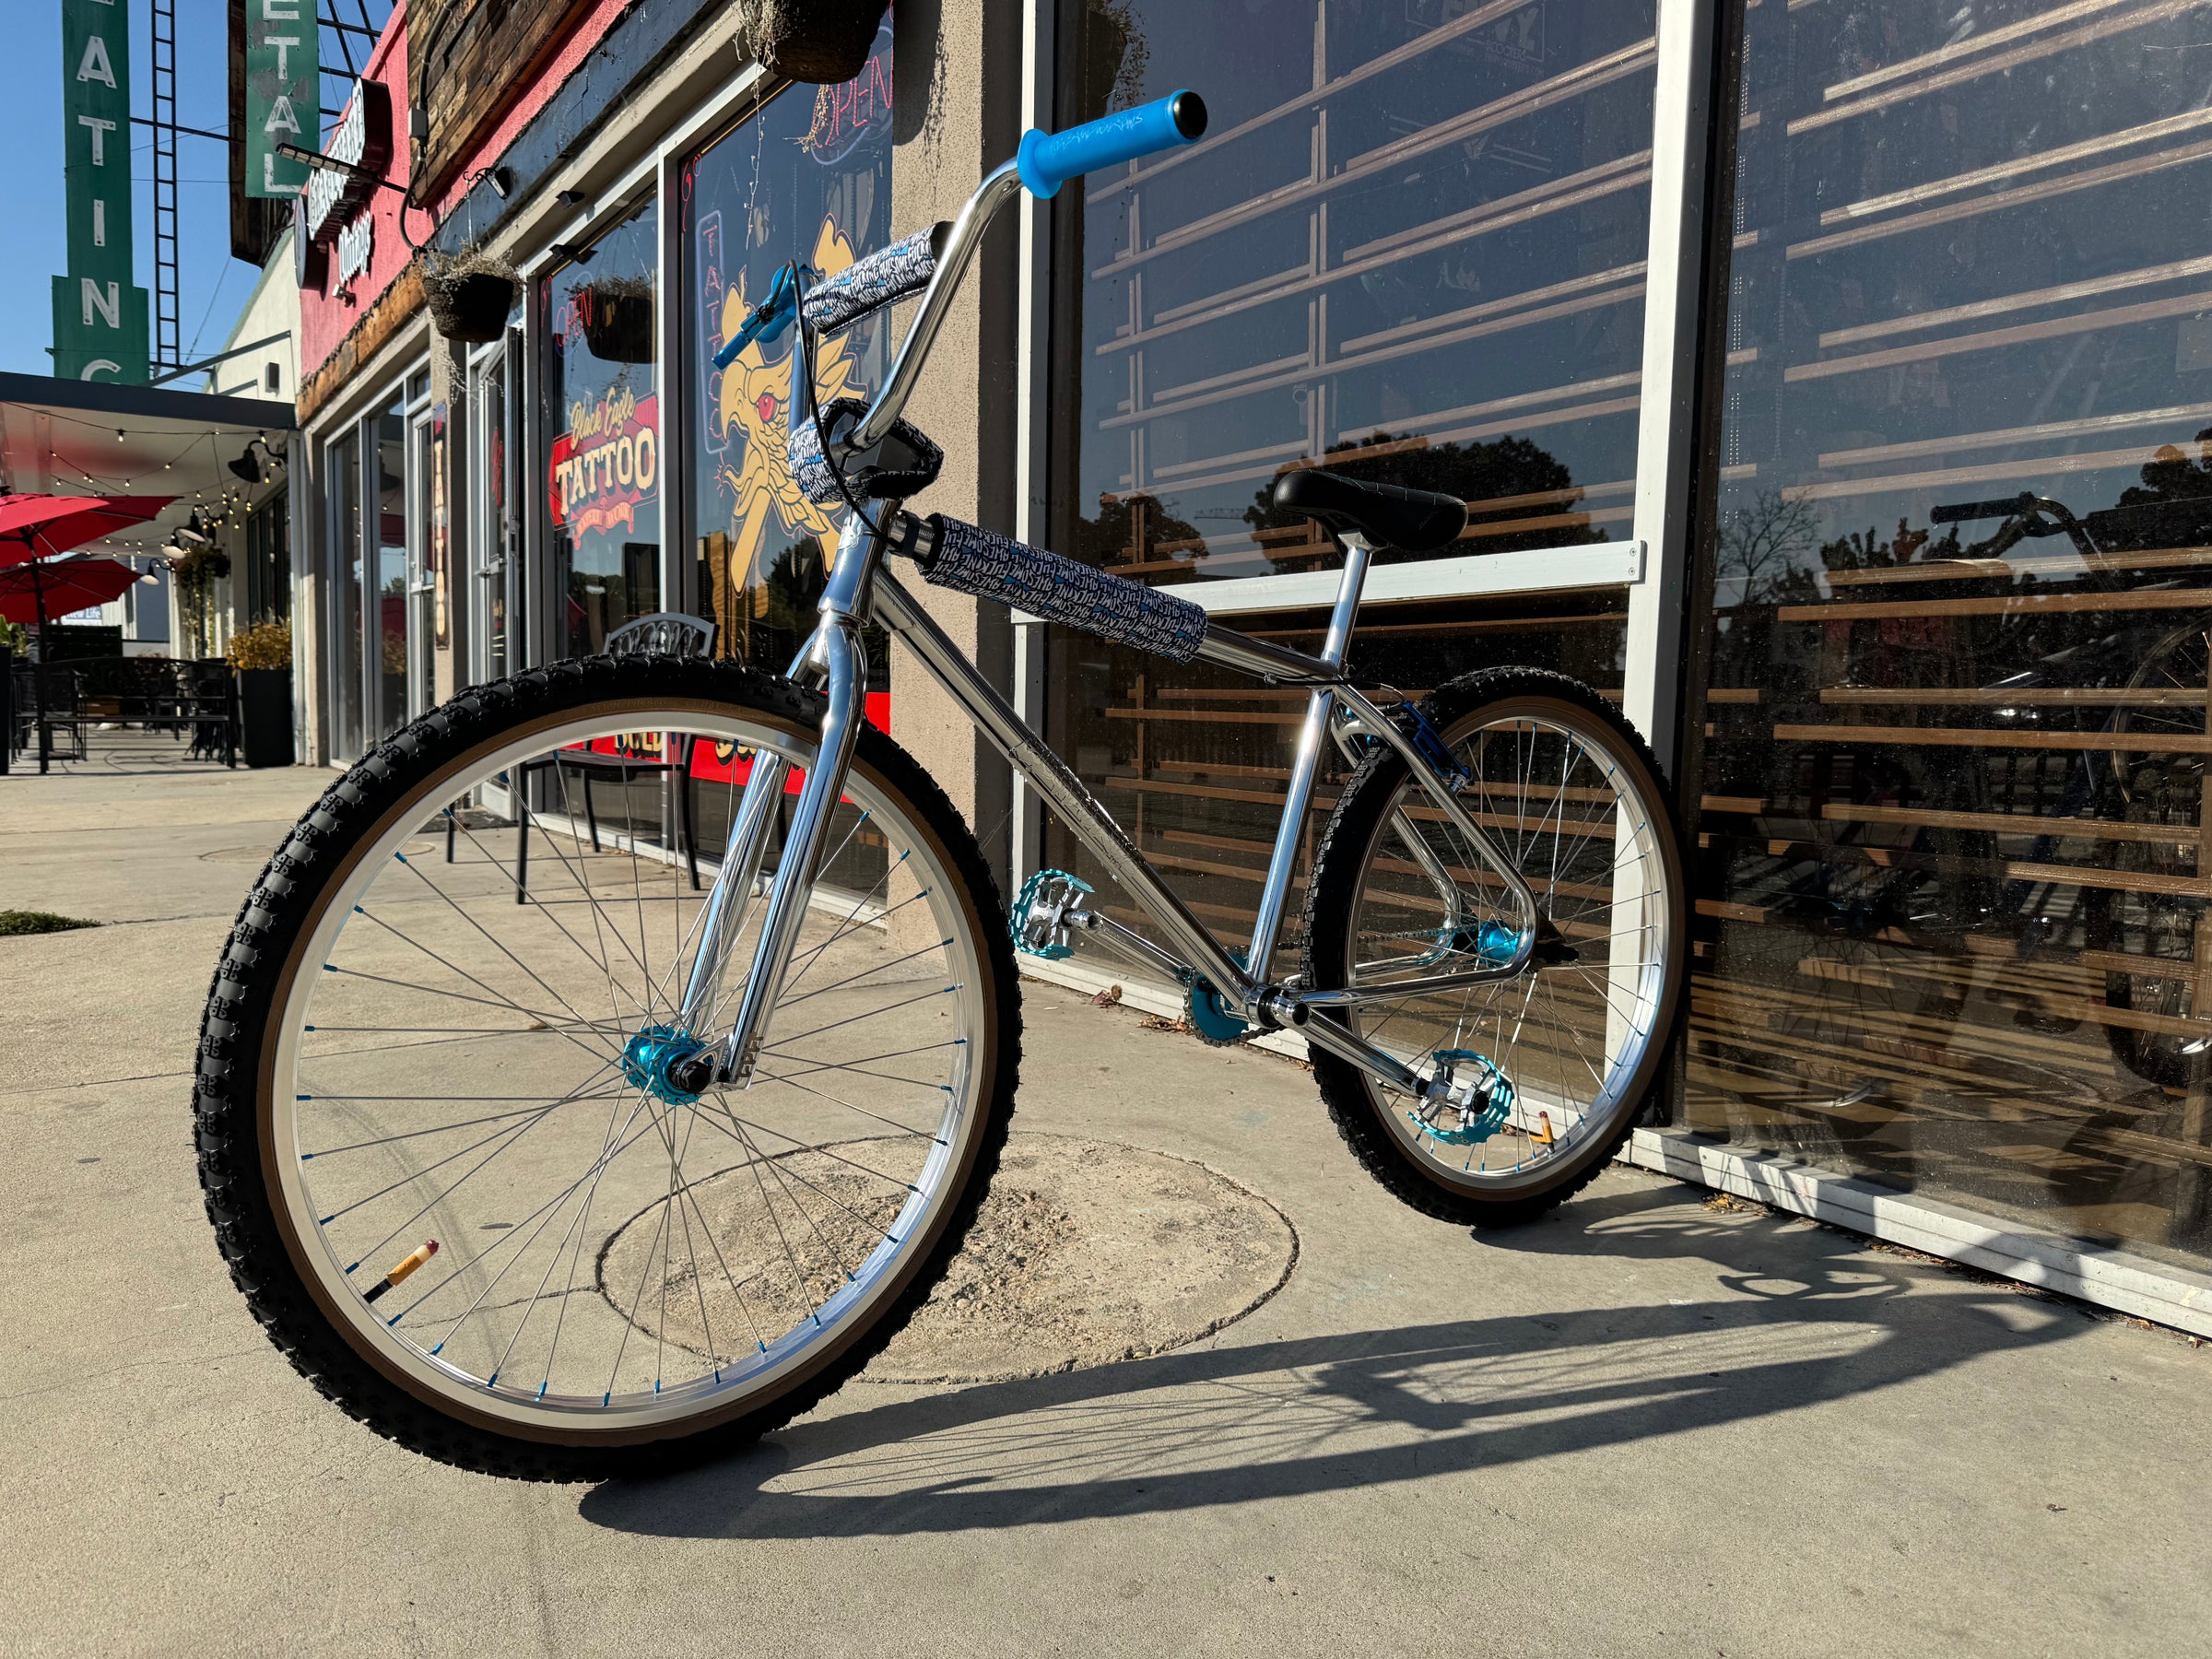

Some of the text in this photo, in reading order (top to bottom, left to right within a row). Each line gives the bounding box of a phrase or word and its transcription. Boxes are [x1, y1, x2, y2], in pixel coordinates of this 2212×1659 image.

[76, 0, 123, 383] ATIN
[556, 286, 593, 347] OPEN
[570, 385, 636, 451] Black Eagle
[555, 427, 656, 517] TATTOO
